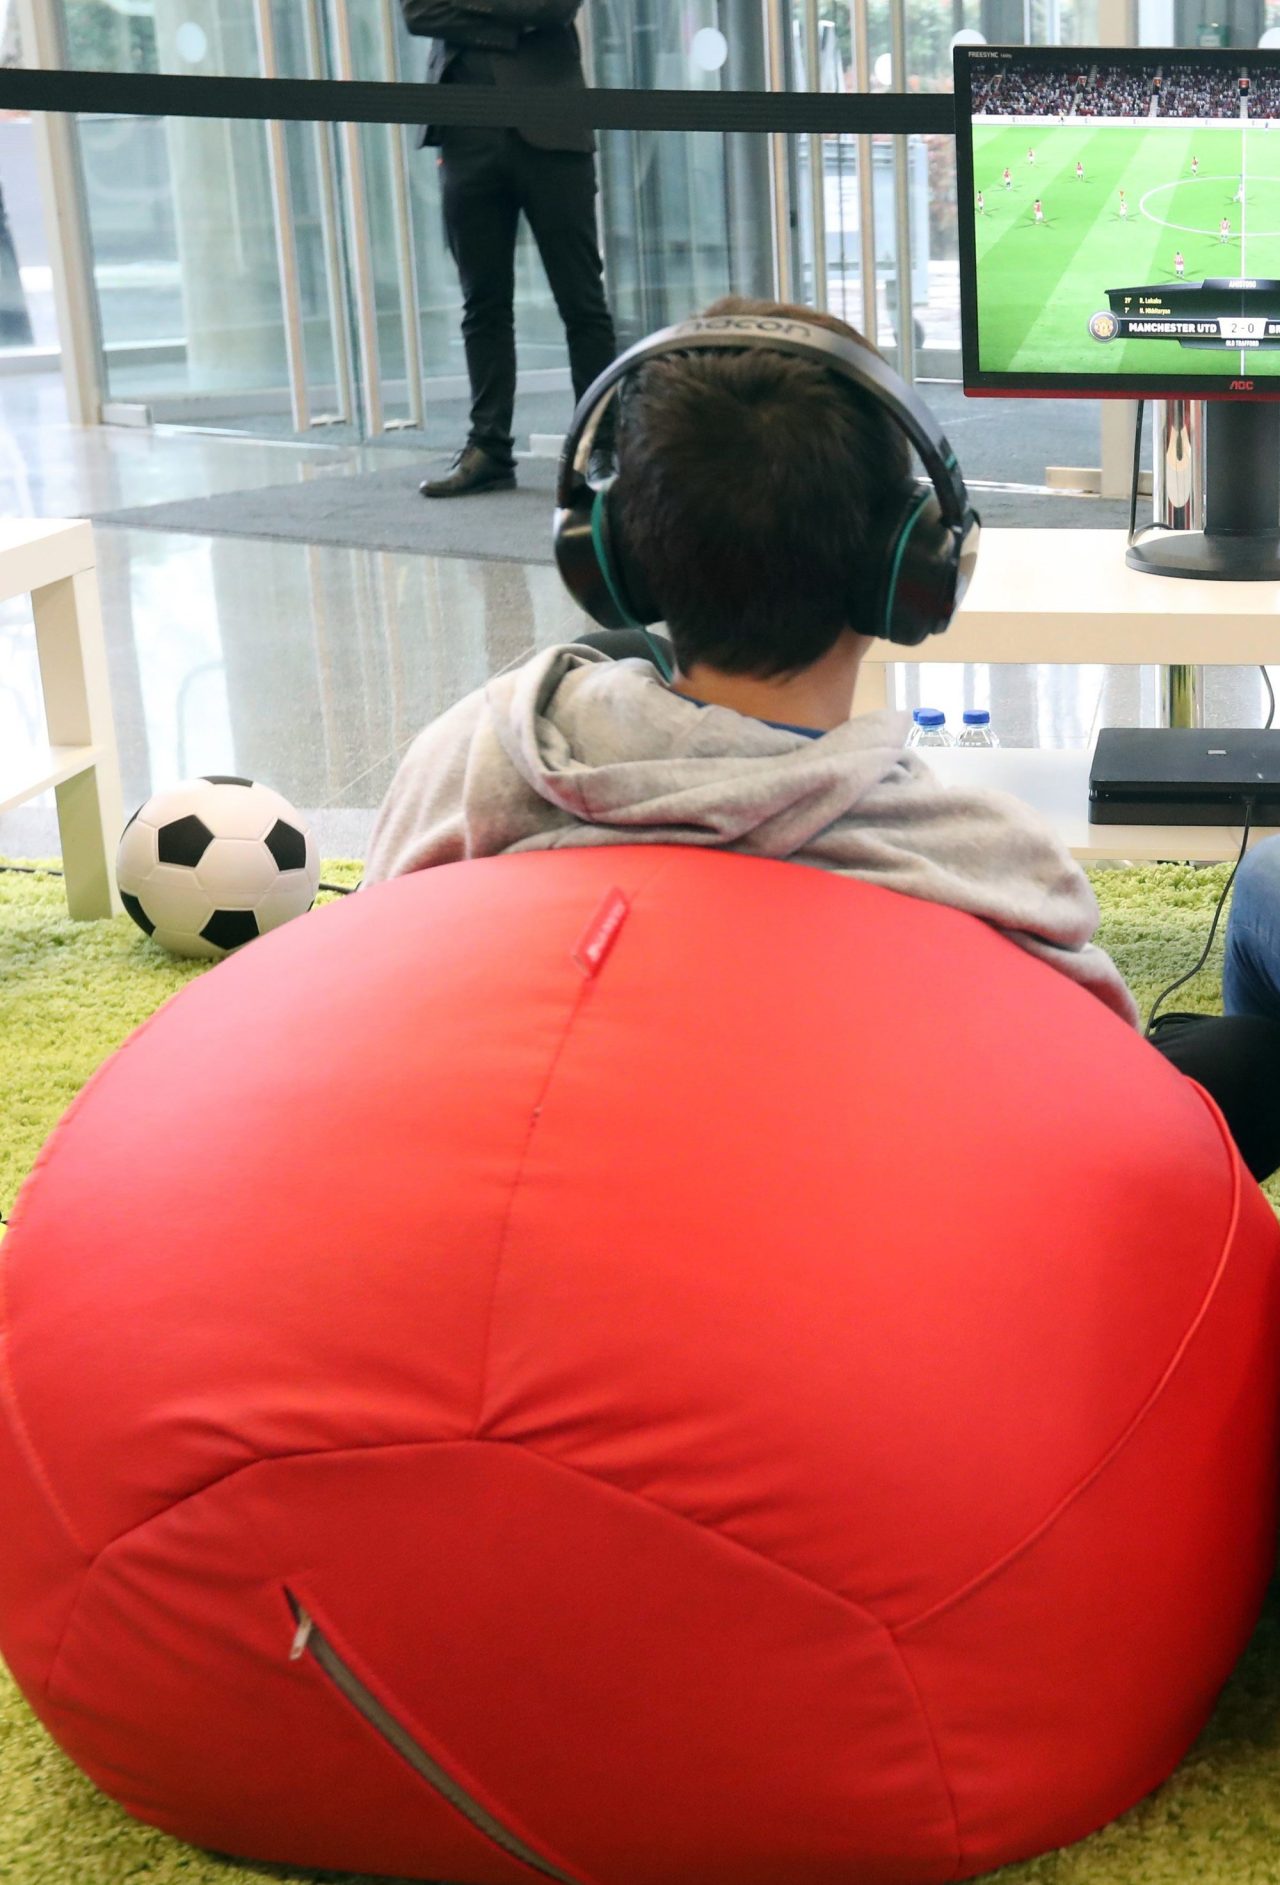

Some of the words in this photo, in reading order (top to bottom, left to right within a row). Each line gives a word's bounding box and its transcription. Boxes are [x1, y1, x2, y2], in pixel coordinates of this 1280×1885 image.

[1128, 323, 1196, 333] MANCHESTER
[1197, 323, 1217, 333] UTD
[1229, 381, 1254, 390] AOC
